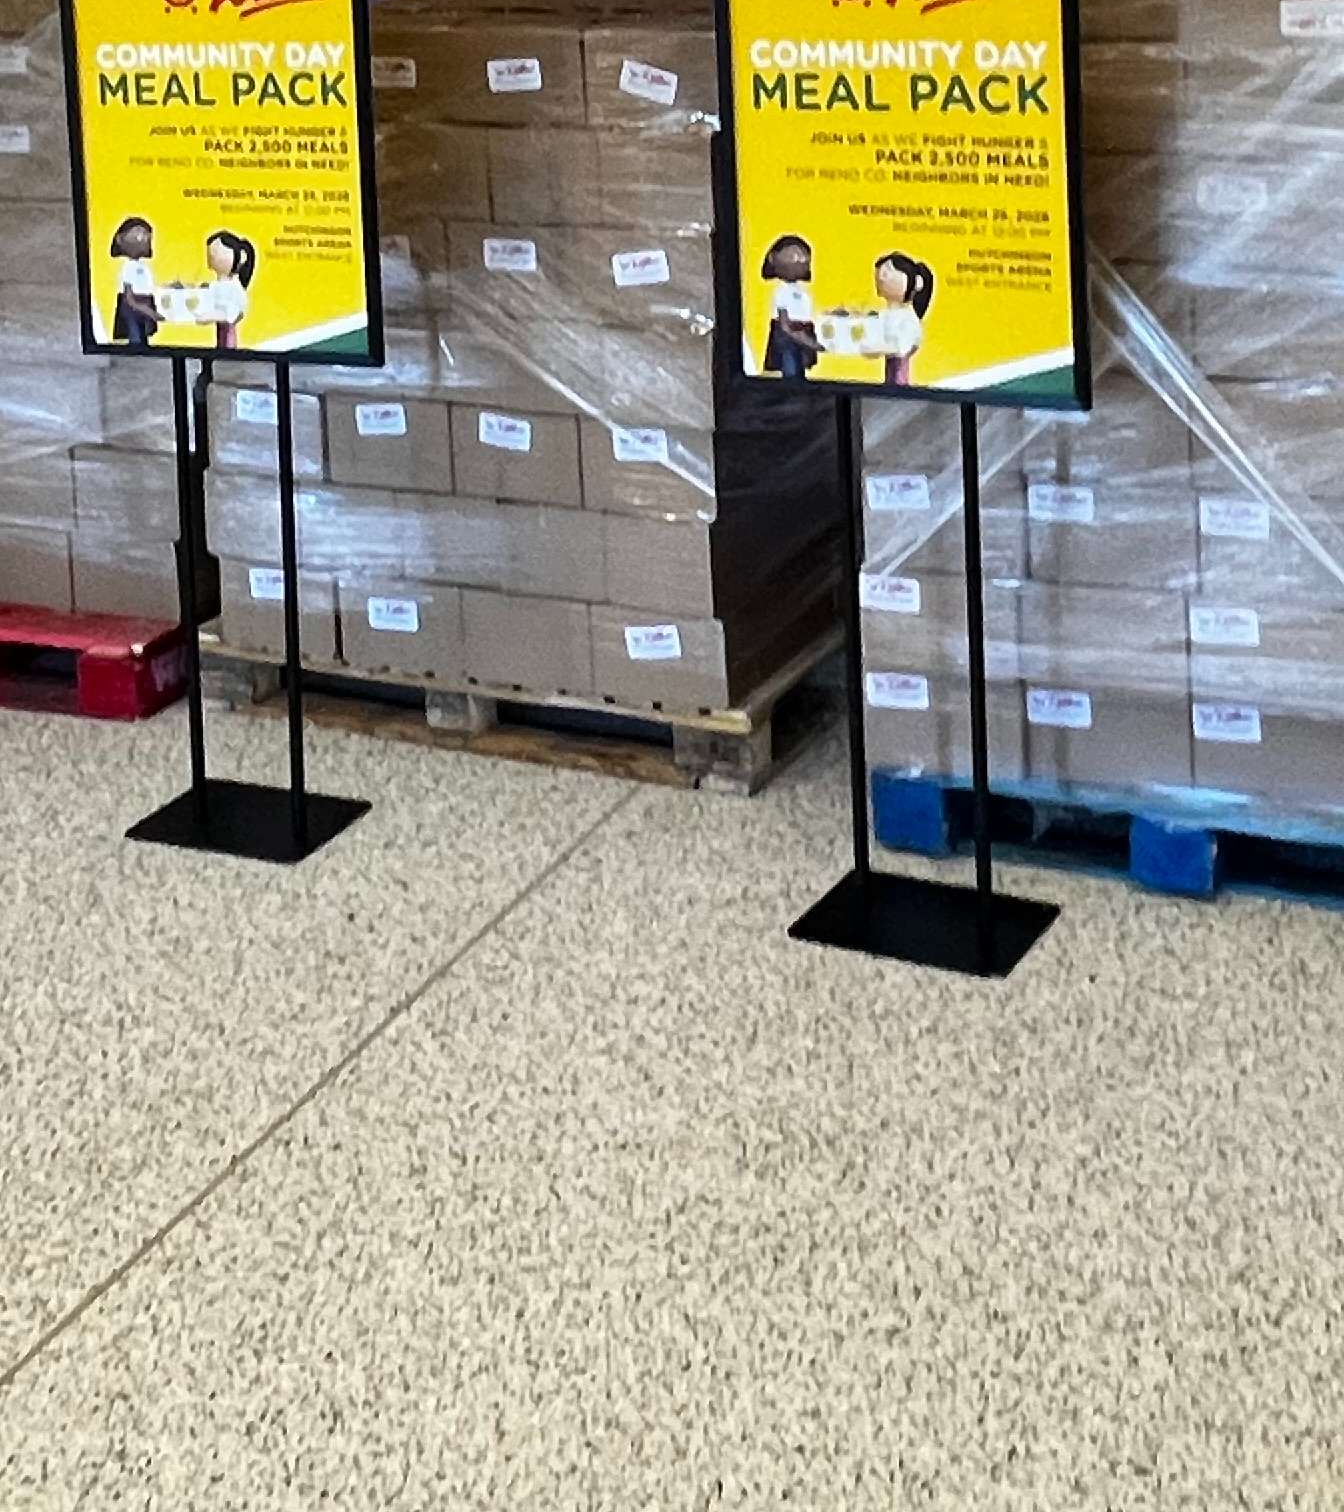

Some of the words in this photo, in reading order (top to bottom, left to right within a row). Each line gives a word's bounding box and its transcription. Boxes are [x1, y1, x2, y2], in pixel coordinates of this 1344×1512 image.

[96, 42, 275, 70] COMMUNITY
[286, 42, 345, 70] DAY
[750, 39, 963, 70] COMMUNITY
[975, 40, 1048, 71] DAY
[98, 71, 217, 107] MEAL
[232, 72, 348, 108] PACK
[752, 72, 890, 112] MEAL
[910, 74, 1049, 114] PACK
[205, 139, 243, 153] PACK
[297, 140, 348, 154] MEALS
[876, 149, 922, 165] PACK
[929, 150, 979, 167] 2,500
[986, 153, 1049, 170] MEALS
